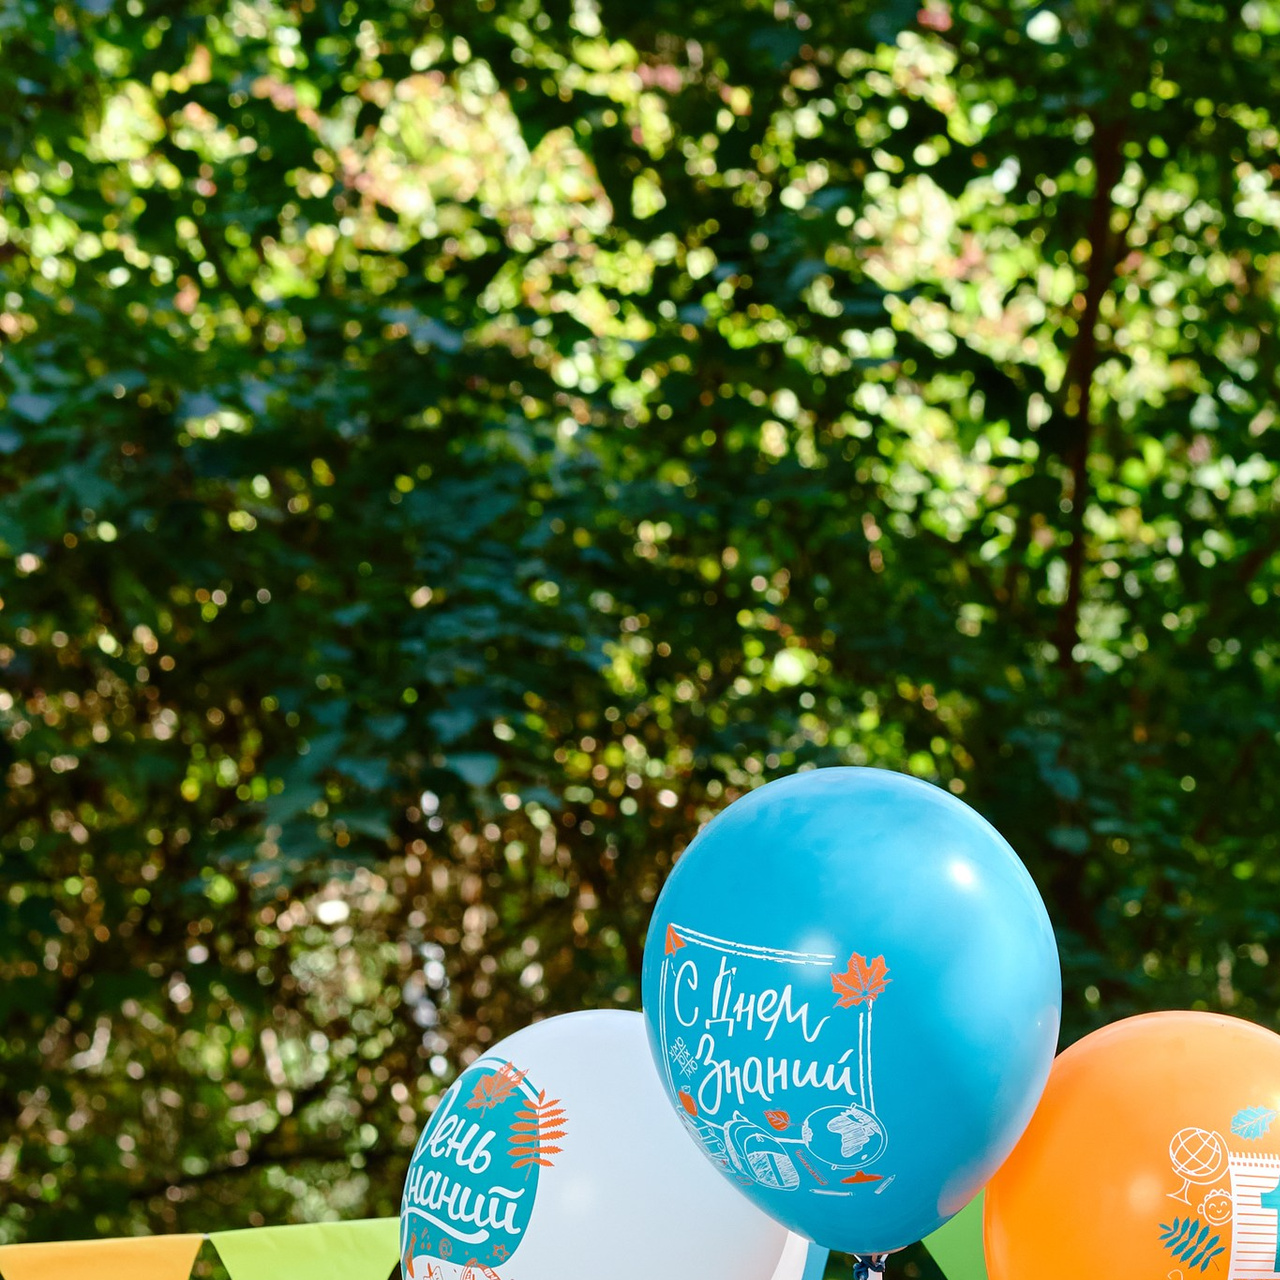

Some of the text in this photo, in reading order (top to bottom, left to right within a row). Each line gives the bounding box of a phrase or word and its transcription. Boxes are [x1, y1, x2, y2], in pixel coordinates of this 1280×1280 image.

[673, 955, 831, 1043] С Днем
[694, 1033, 858, 1116] Знаний
